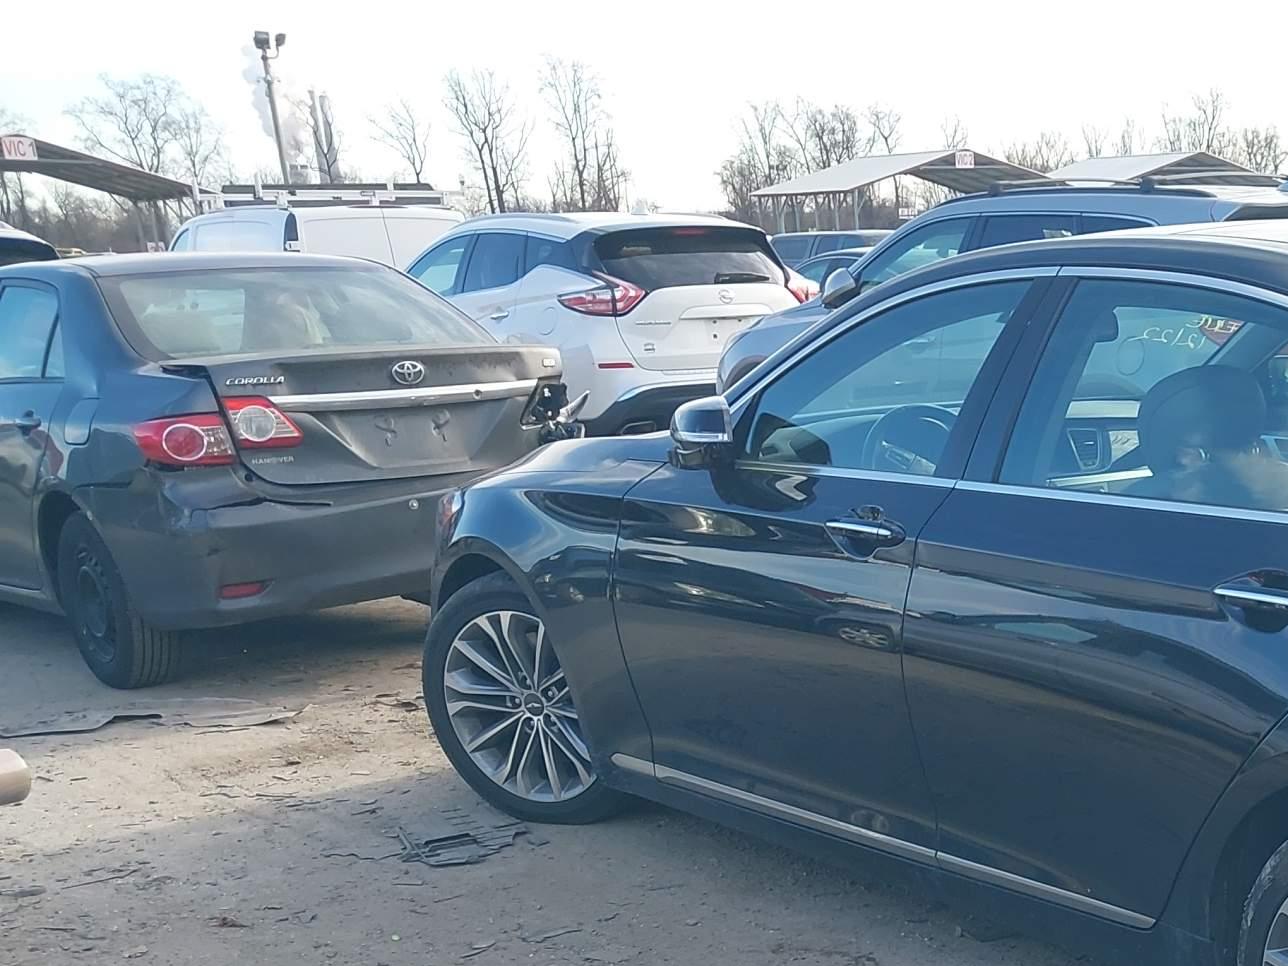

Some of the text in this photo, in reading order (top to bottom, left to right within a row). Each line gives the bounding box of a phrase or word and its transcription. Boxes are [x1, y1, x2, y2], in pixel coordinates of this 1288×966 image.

[3, 139, 36, 157] VIC 1
[225, 375, 286, 386] COROLLA
